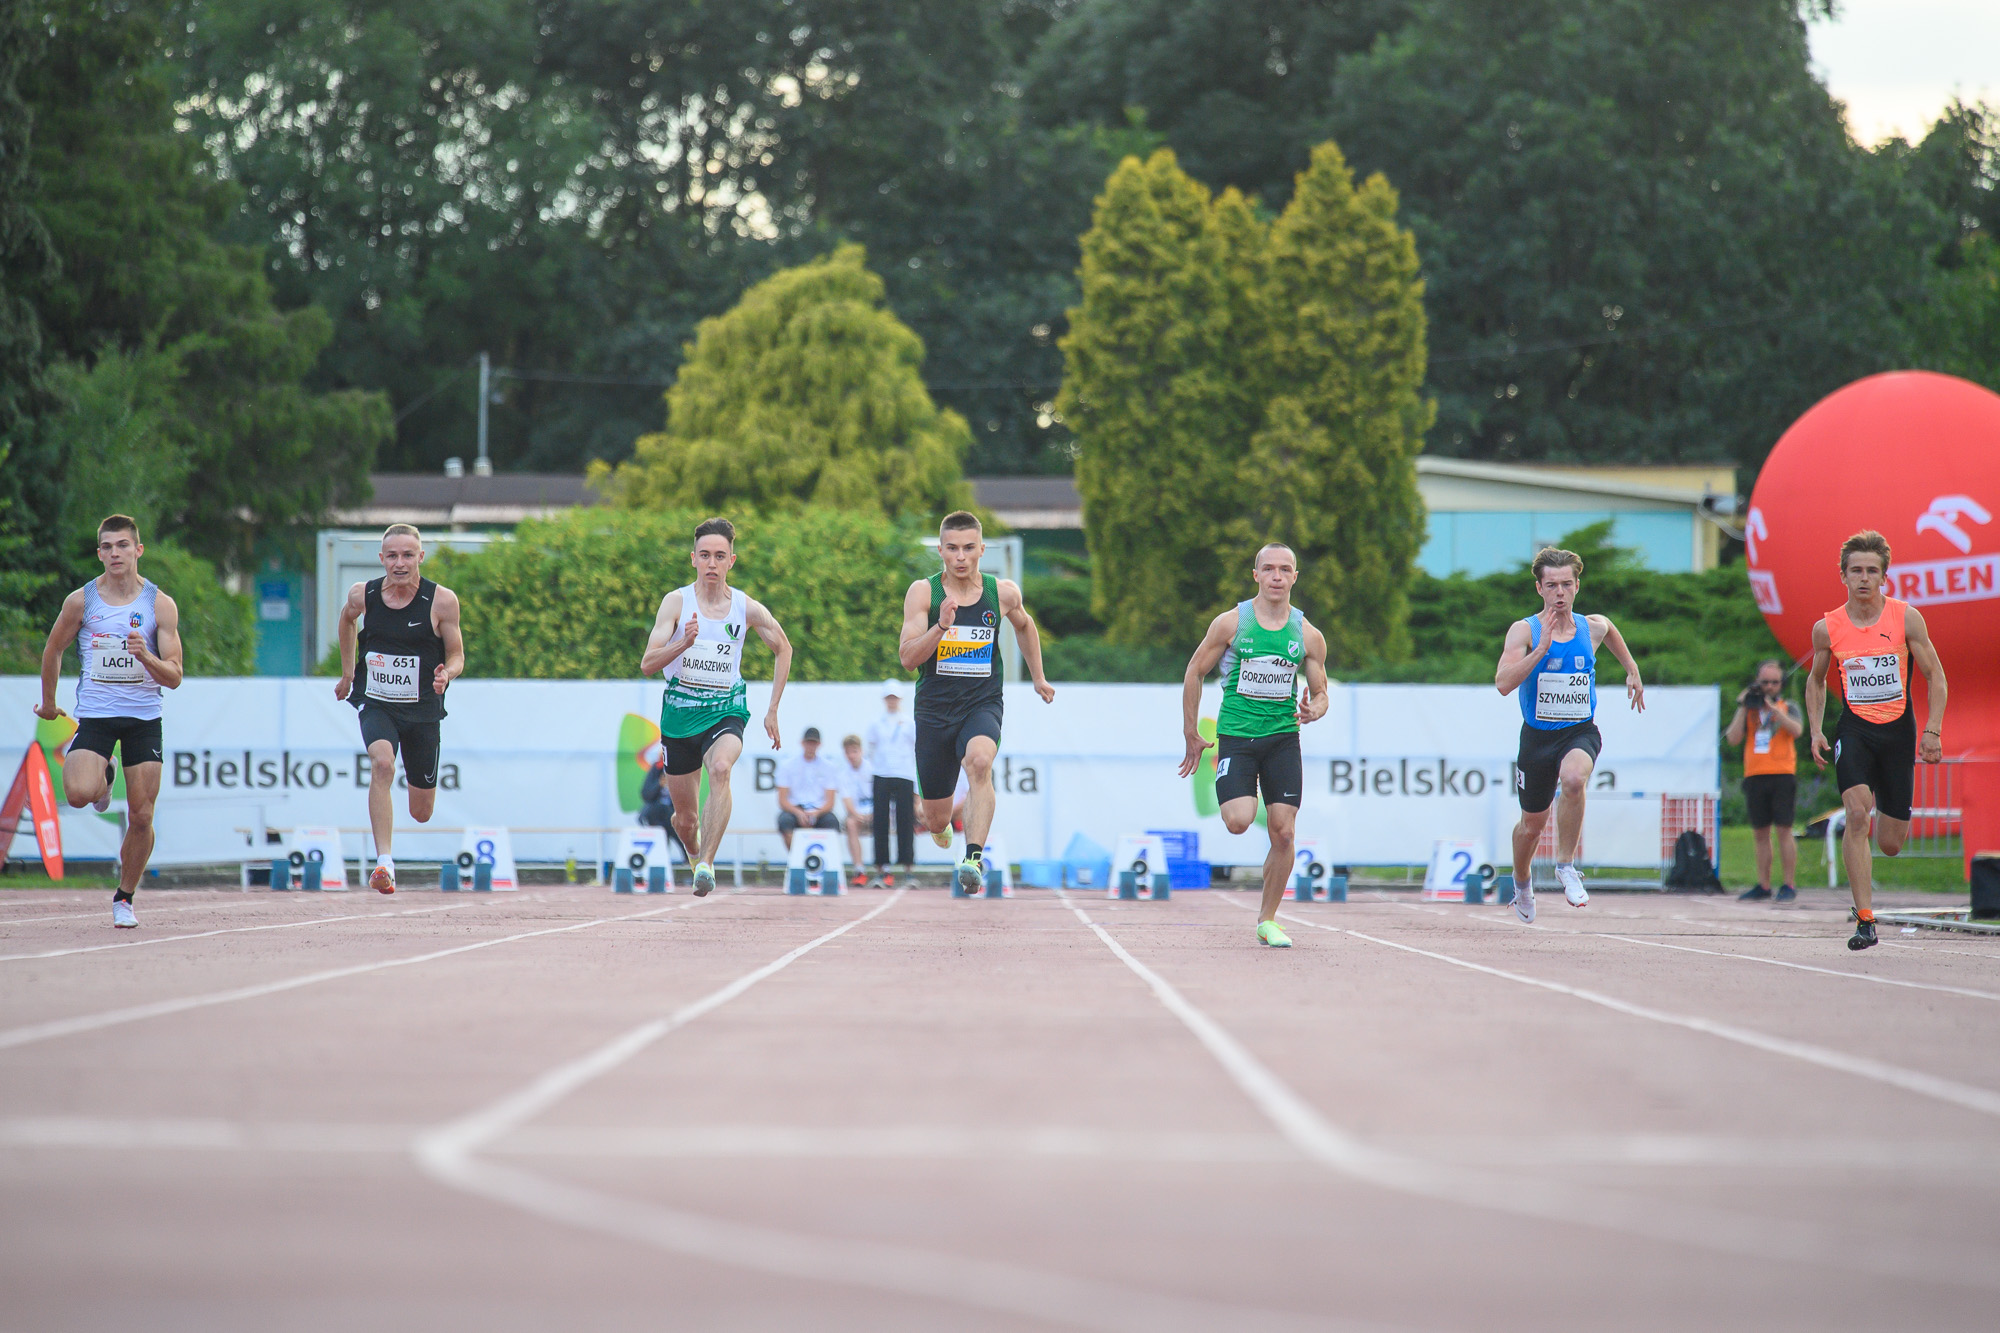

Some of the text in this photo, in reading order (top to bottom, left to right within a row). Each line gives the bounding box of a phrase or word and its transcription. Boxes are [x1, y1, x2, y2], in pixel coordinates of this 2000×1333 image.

[971, 629, 991, 639] 528
[717, 643, 731, 655] 92
[940, 645, 991, 659] ZAKRZEWSKI
[102, 656, 133, 668] LACH
[393, 657, 416, 668] 651
[682, 656, 733, 673] BAJRASZEWSKI
[1873, 655, 1897, 668] 733
[372, 671, 412, 685] LIBURA
[1241, 670, 1292, 683] GORZKOWICZ
[1569, 675, 1588, 686] 260
[1849, 673, 1898, 687] WRÓBEL
[1538, 691, 1590, 704] SZYMAŃSKI
[1451, 851, 1472, 885] 2
